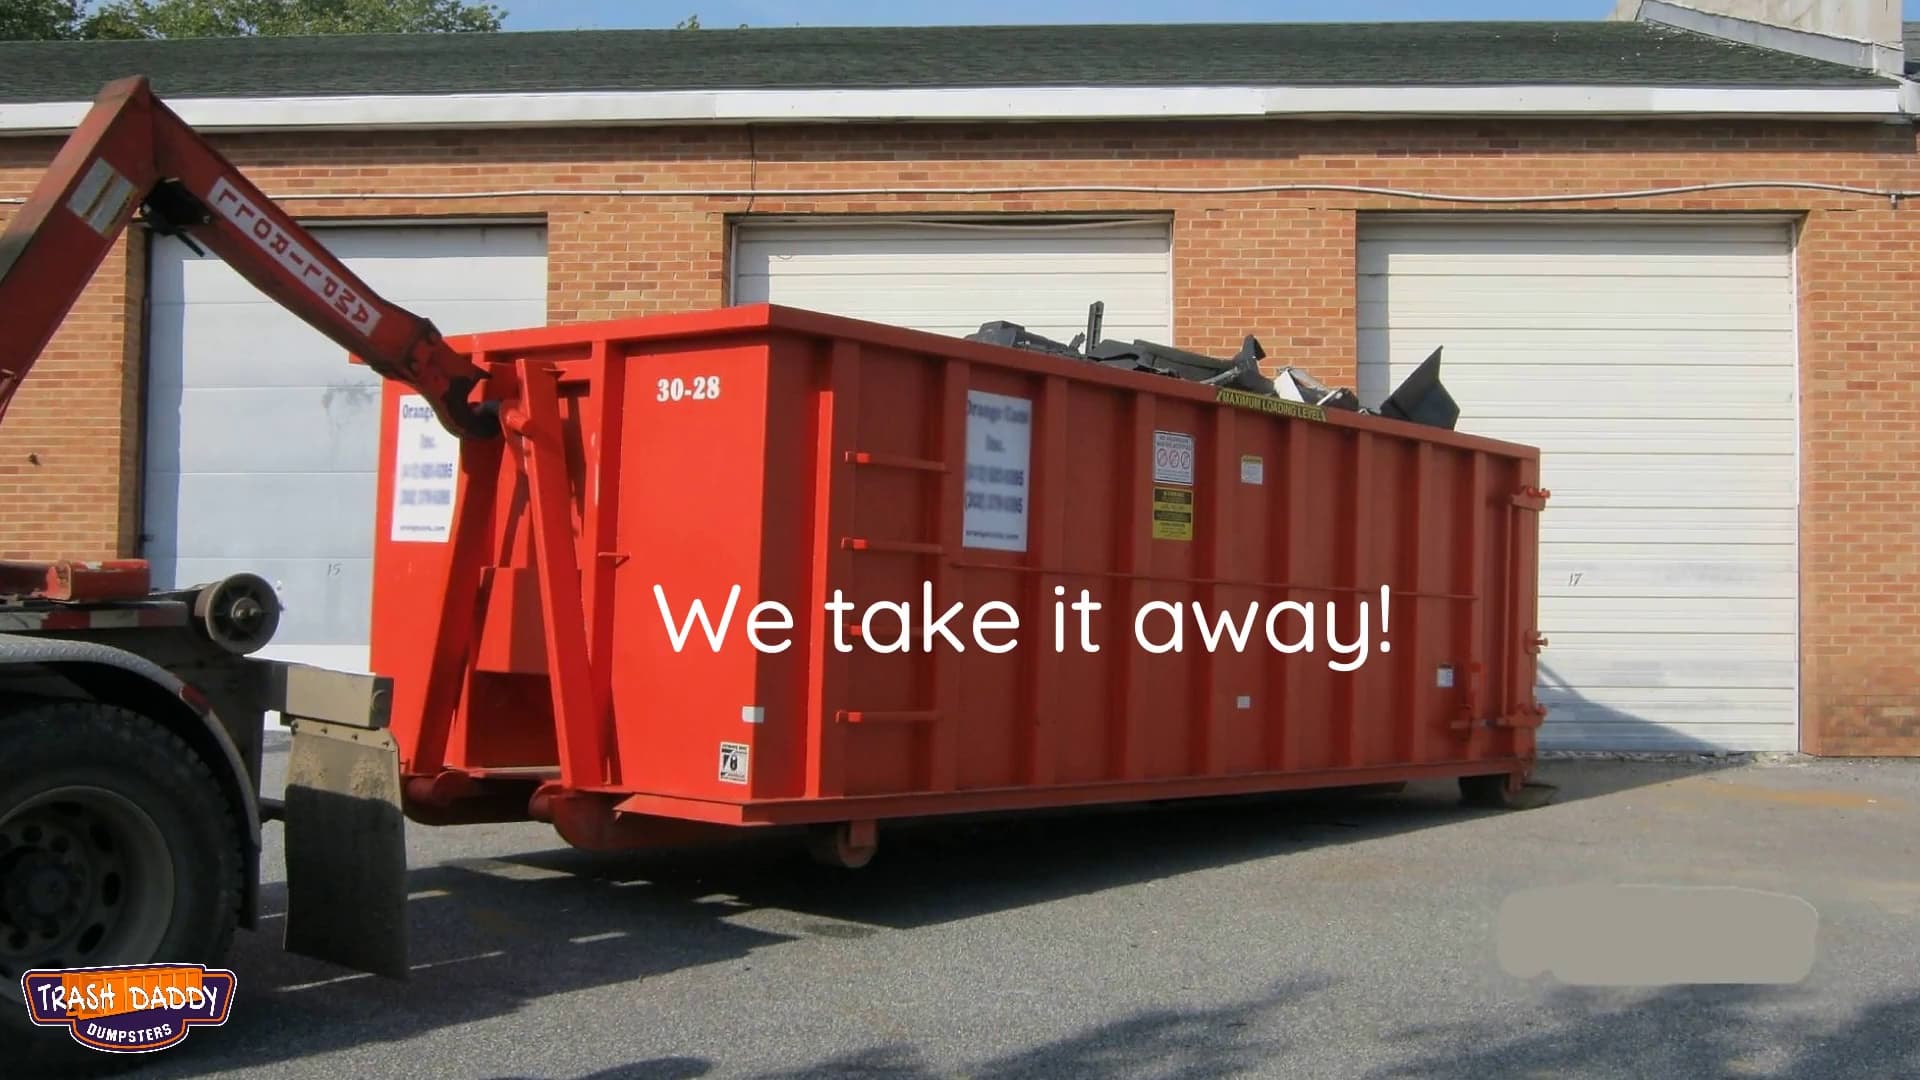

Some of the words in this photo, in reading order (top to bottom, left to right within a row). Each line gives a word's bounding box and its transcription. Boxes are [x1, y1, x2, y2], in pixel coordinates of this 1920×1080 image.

[656, 375, 720, 403] 30-28
[1221, 391, 1261, 410] MAXIMUM
[1262, 399, 1297, 417] LOADING
[1297, 407, 1322, 421] LEVEL
